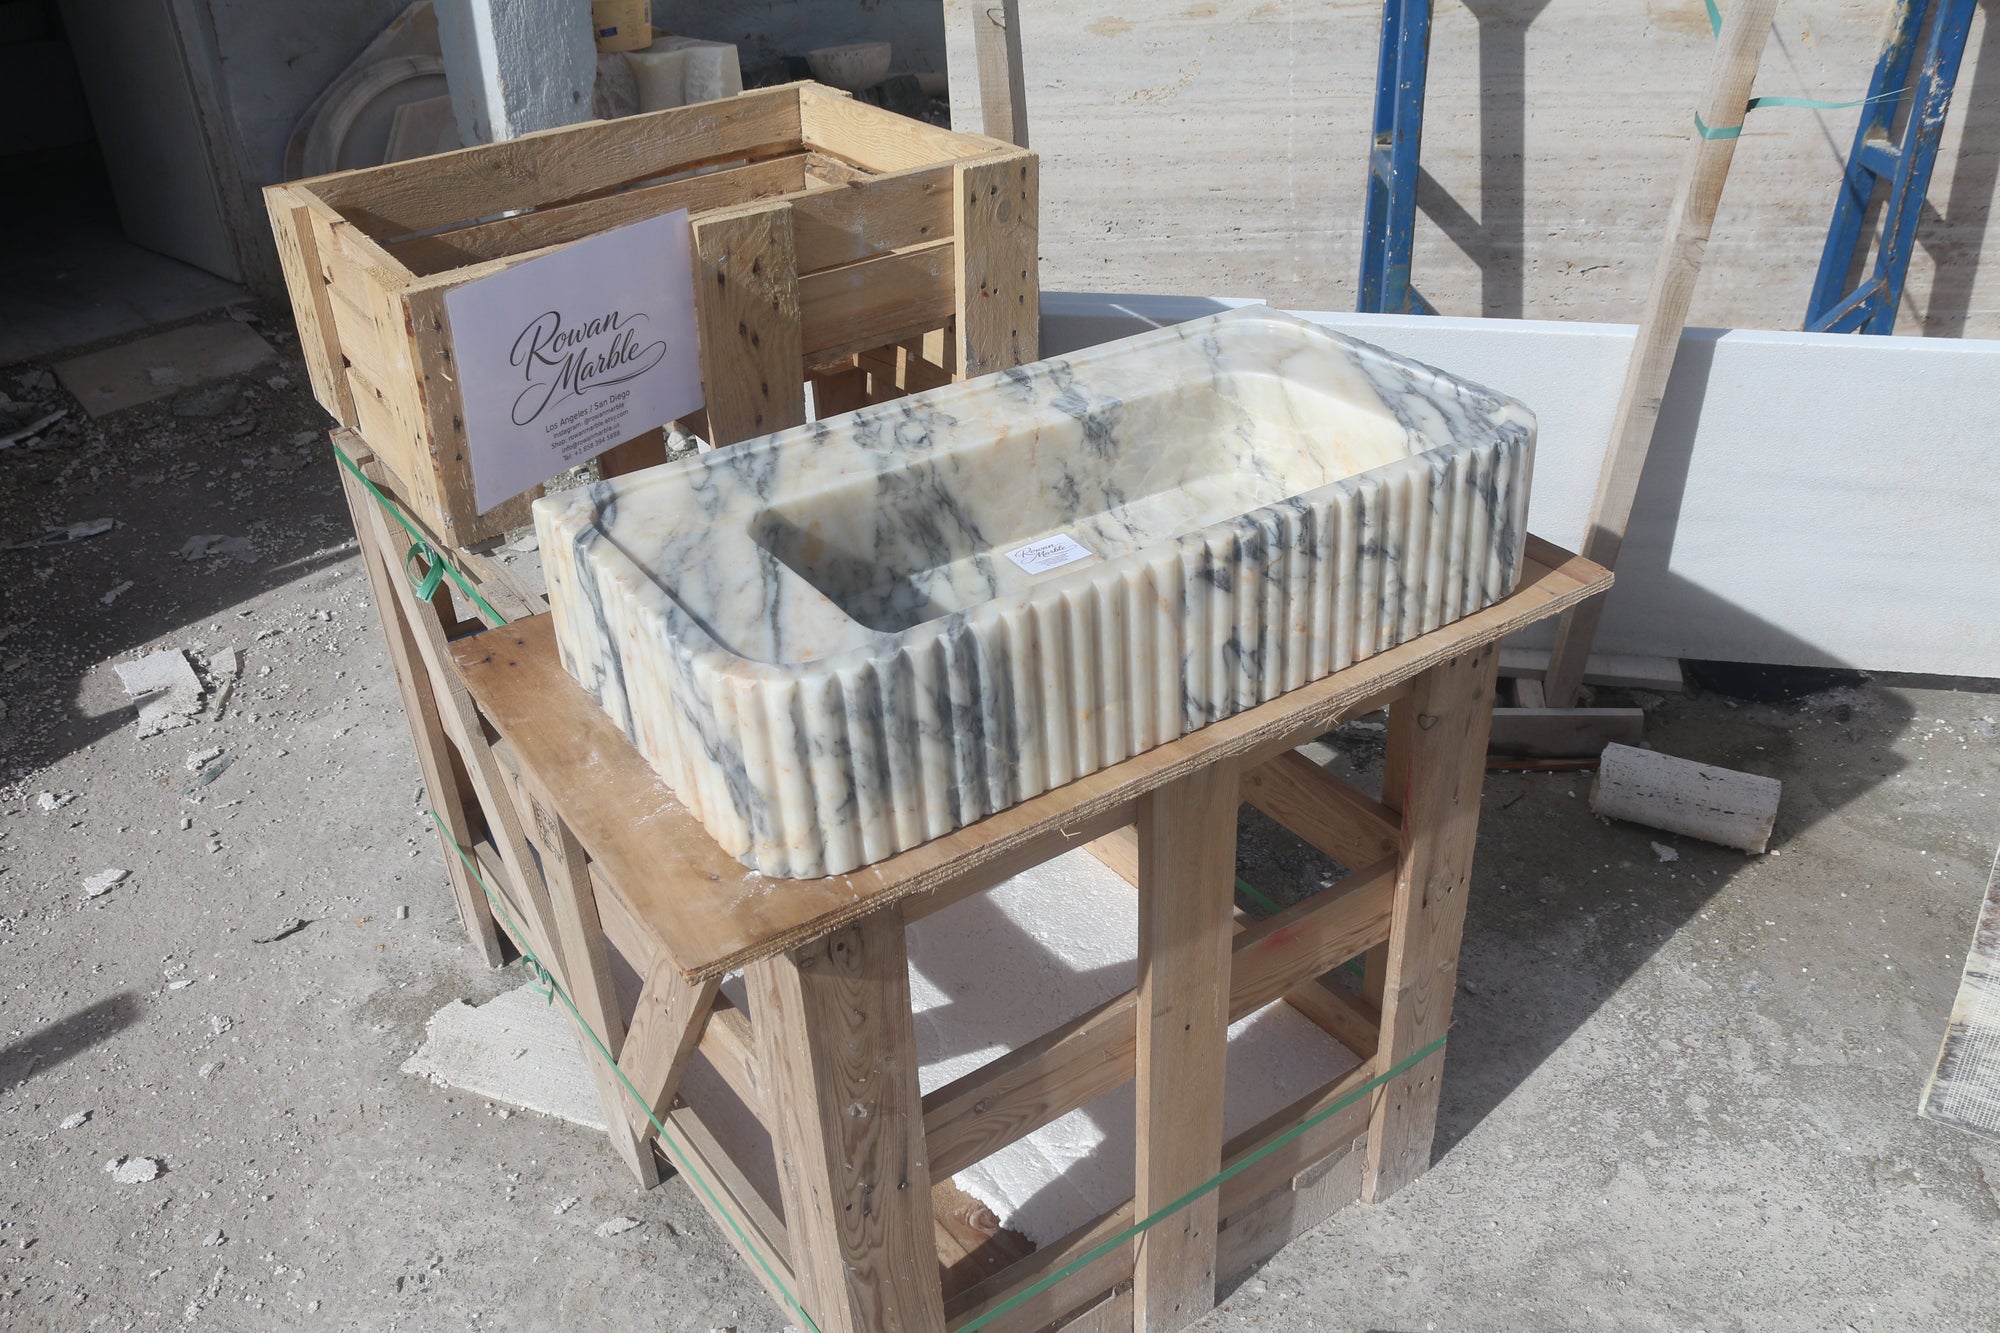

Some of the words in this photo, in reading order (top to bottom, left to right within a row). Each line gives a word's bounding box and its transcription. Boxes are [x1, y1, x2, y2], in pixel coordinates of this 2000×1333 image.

[510, 311, 650, 381] Rowan
[511, 328, 667, 426] Marble
[545, 423, 558, 433] Los
[560, 408, 588, 426] Angeles
[594, 400, 608, 410] San
[609, 390, 631, 403] Diego
[551, 439, 567, 450] Shop:
[1014, 543, 1056, 558] Rowan
[1021, 544, 1078, 565] Marble
